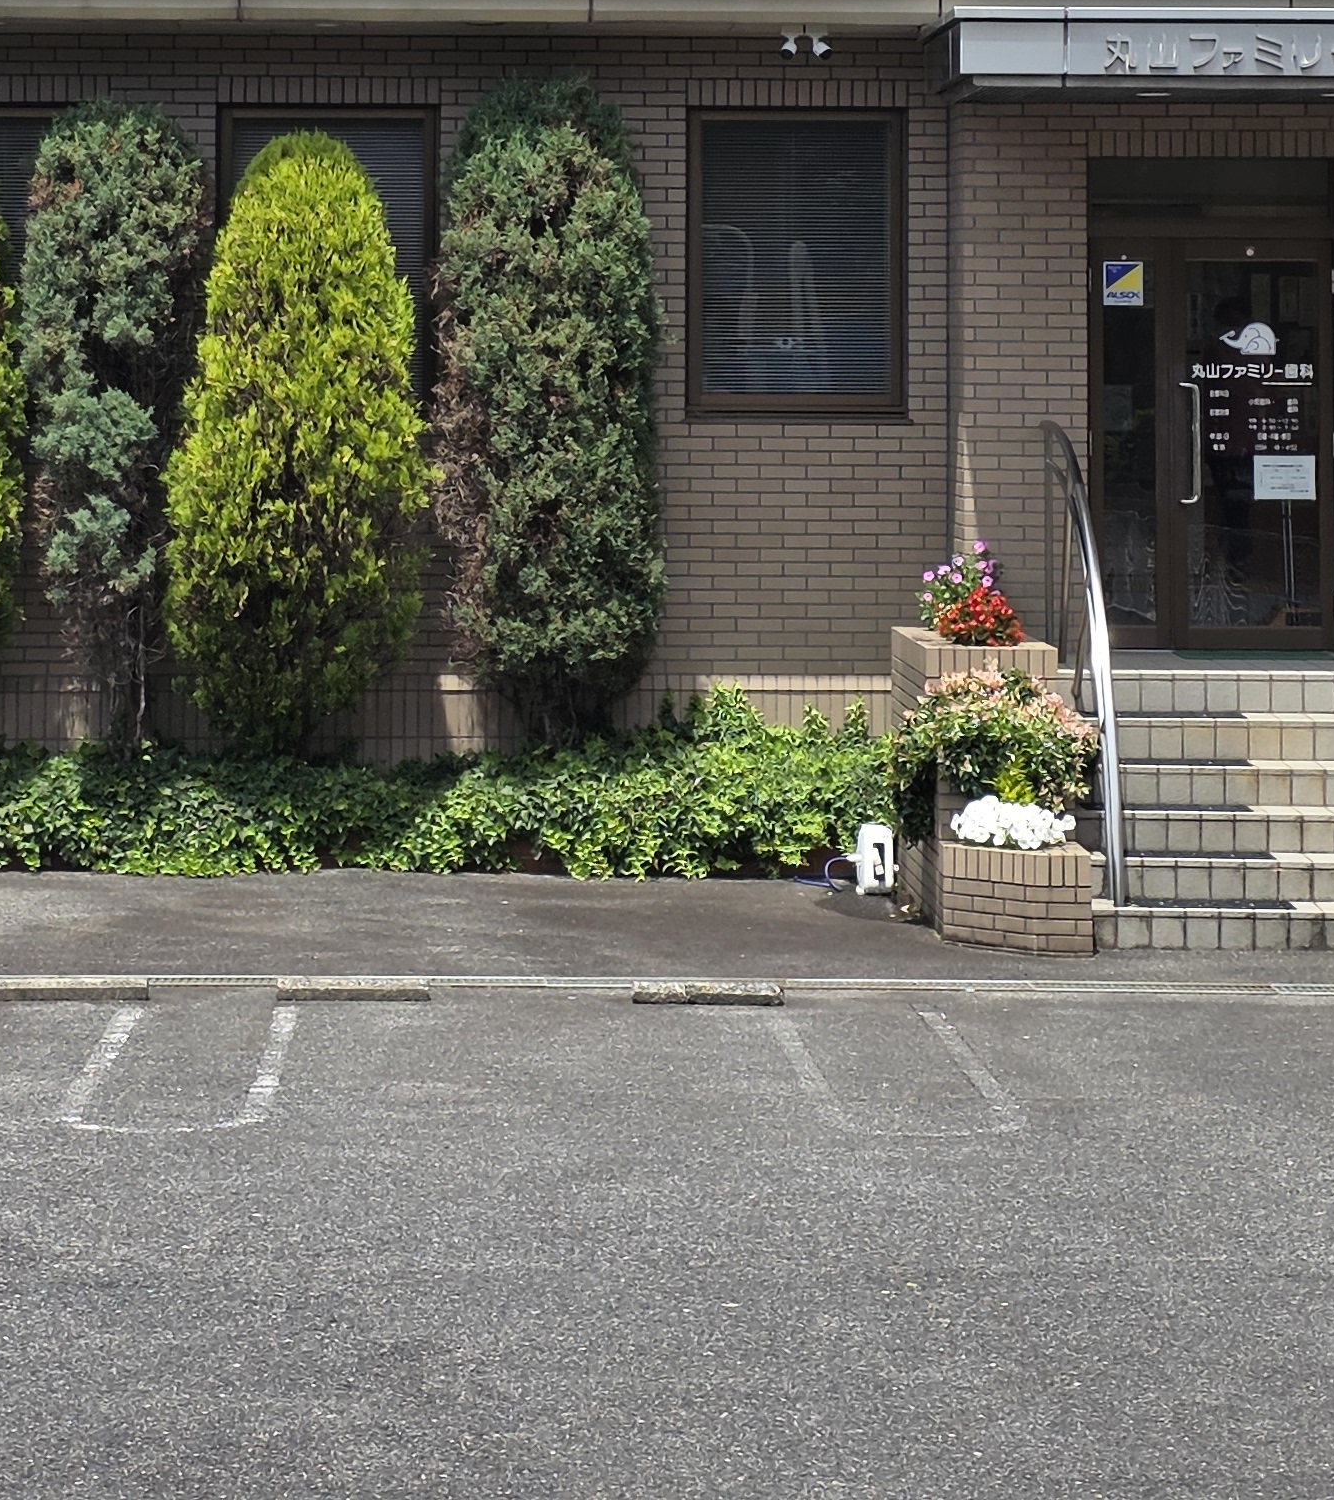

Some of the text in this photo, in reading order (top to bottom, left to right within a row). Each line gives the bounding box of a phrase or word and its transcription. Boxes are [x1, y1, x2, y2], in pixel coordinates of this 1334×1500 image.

[1191, 363, 1313, 379] 丸山ファミリー歯科
